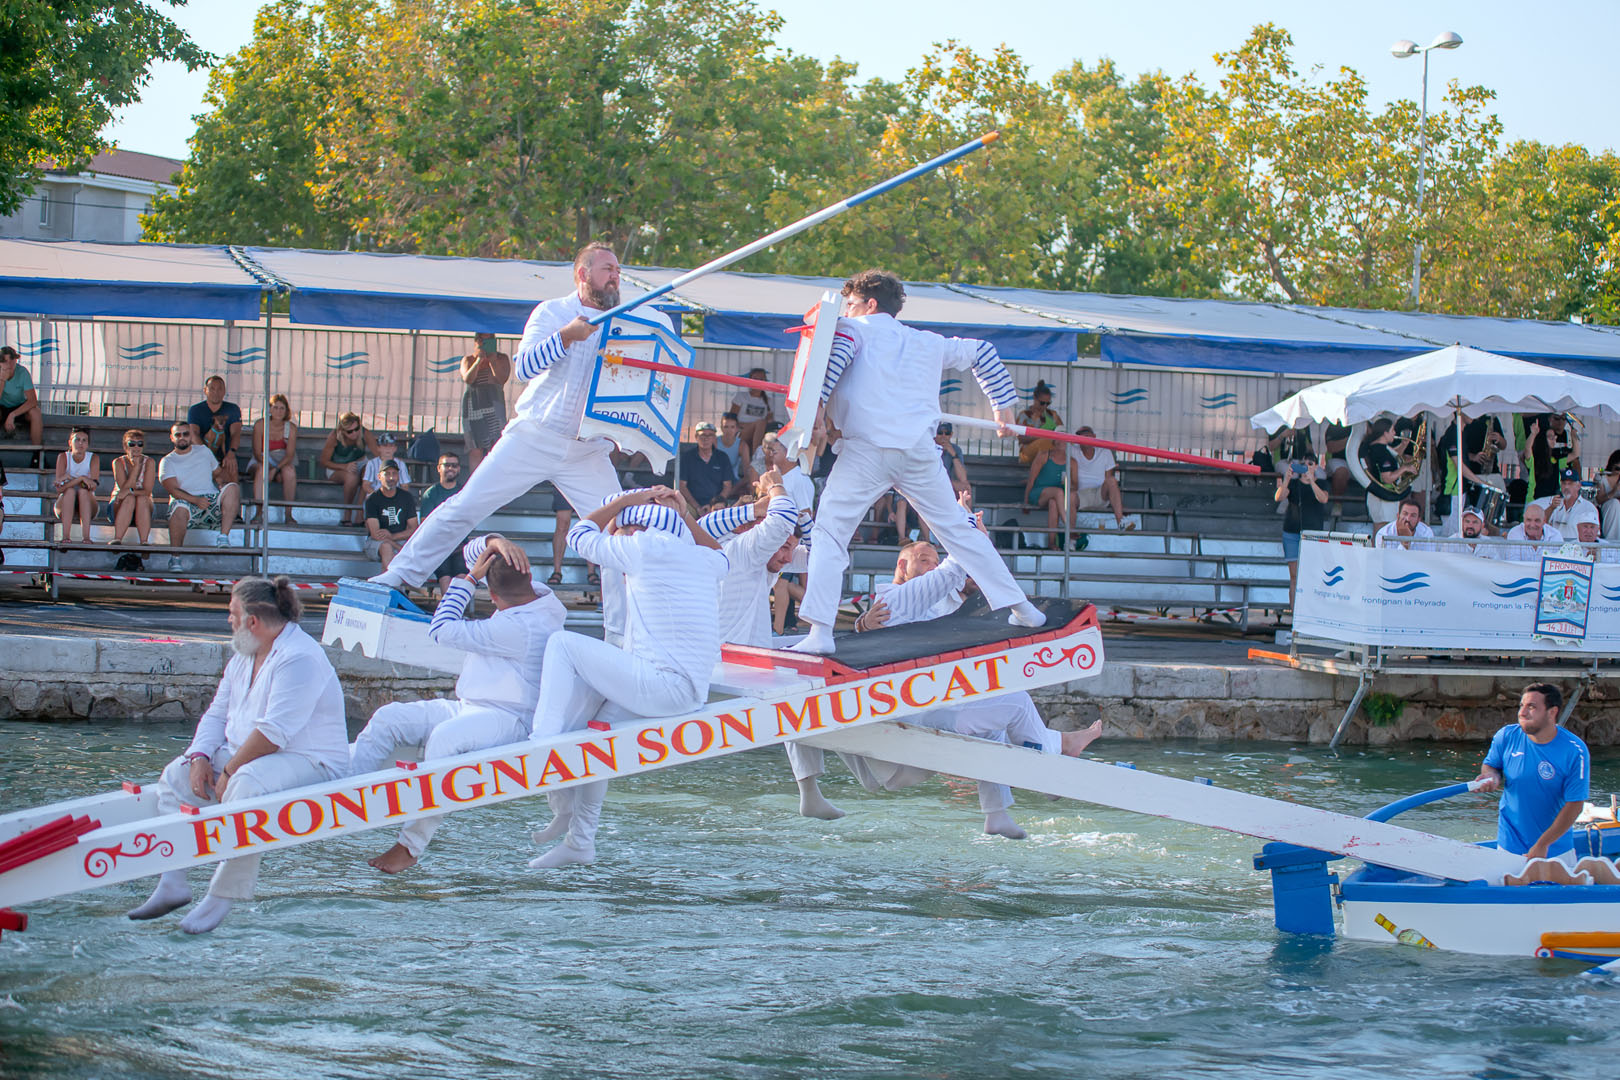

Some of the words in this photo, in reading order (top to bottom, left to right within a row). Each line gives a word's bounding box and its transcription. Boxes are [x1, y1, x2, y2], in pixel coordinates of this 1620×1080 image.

[1361, 596, 1402, 607] Frontignan
[1404, 598, 1412, 606] la
[1414, 598, 1446, 608] Peyrade
[1472, 600, 1513, 611] Frontignan
[1546, 623, 1556, 632] 14
[188, 735, 619, 858] FRONTIGNAN
[637, 707, 755, 766] SON
[774, 655, 1009, 738] MUSCAT
